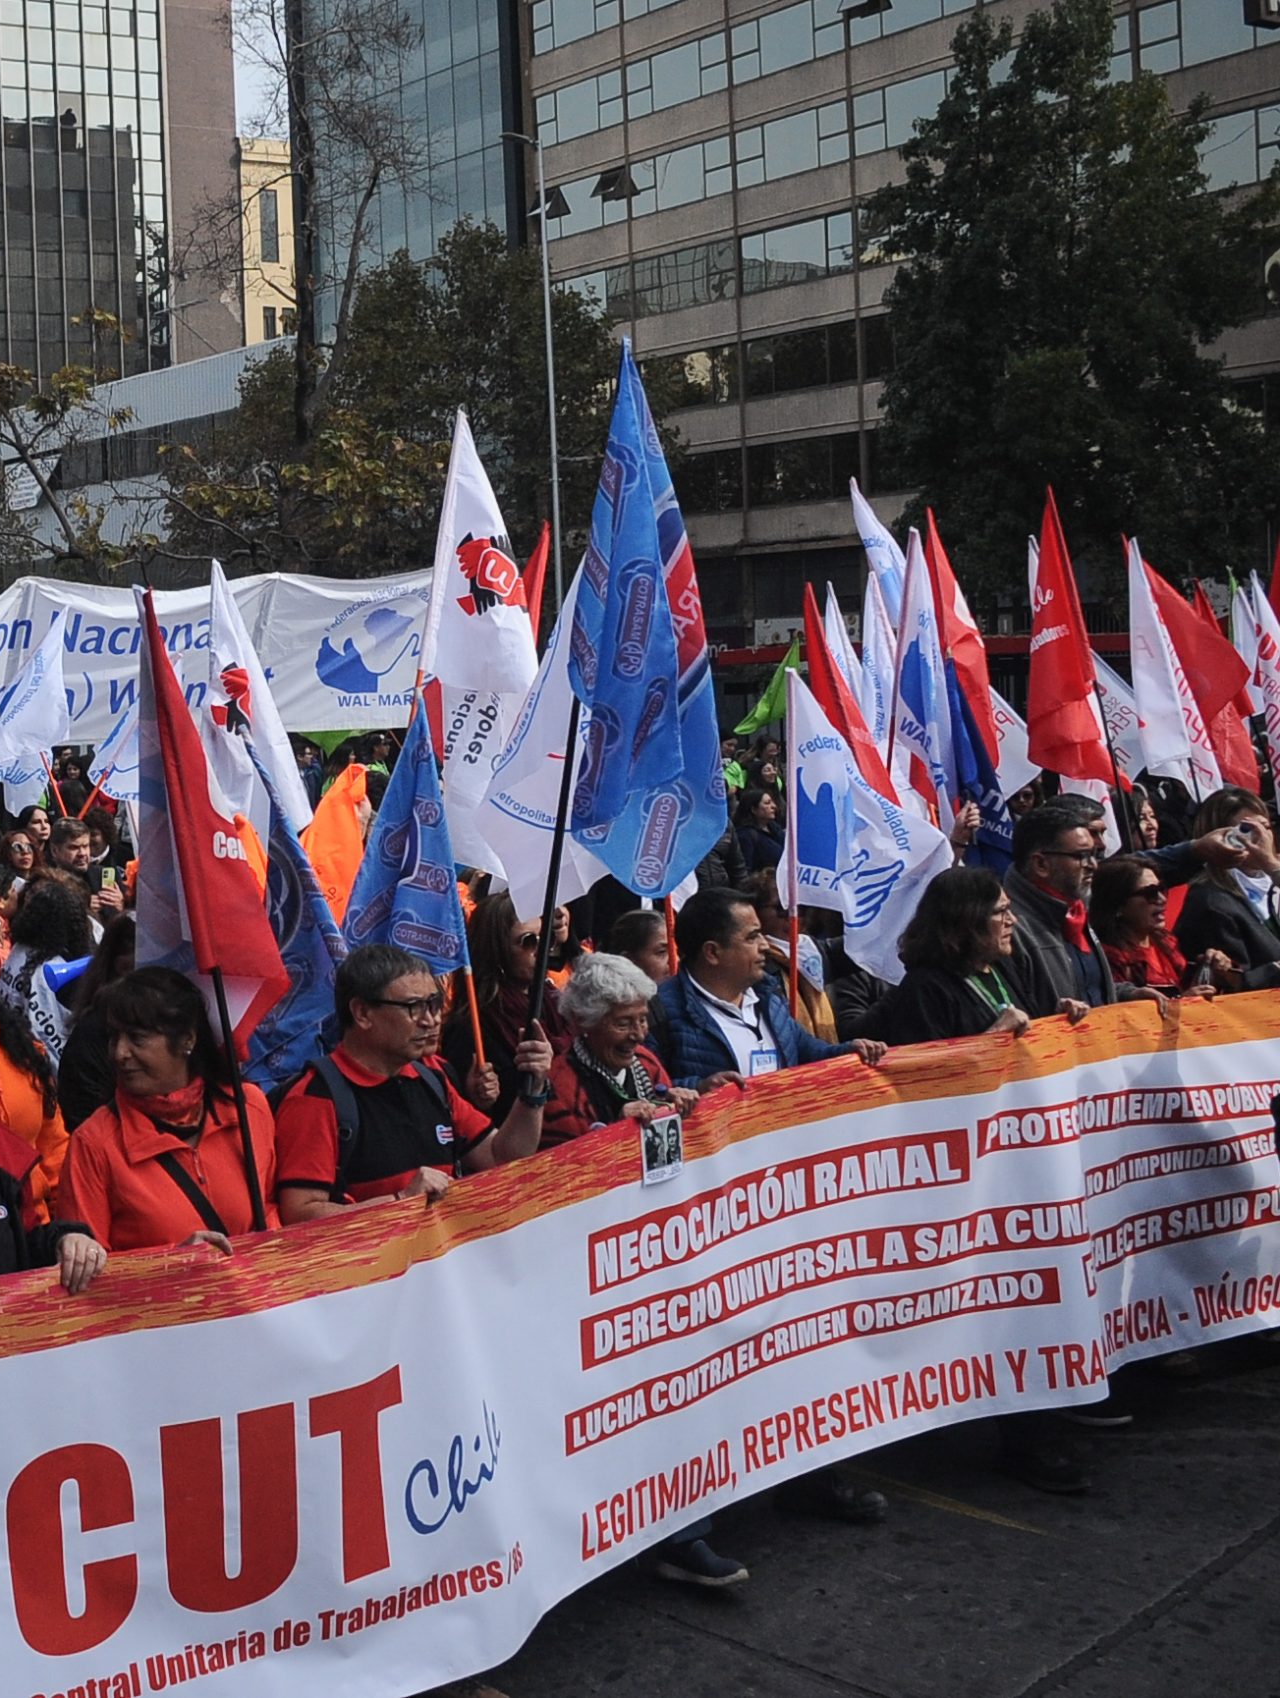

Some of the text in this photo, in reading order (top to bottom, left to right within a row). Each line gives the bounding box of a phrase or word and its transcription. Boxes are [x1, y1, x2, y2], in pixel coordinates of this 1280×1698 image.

[337, 693, 415, 707] WAL-MAR
[1127, 1089, 1214, 1121] EMPLEO
[1128, 1143, 1233, 1181] IMPUNIDAD
[1230, 1142, 1243, 1162] Y
[1243, 1132, 1277, 1160] NEGA
[593, 1141, 962, 1289] NEGOCIACIÓN RAMAL
[1167, 1197, 1250, 1240] SALUD
[592, 1281, 723, 1361] DERECHO
[723, 1235, 878, 1312] UNIVERSAL
[882, 1231, 910, 1266] A
[913, 1212, 1000, 1263] SALA
[572, 1272, 1044, 1449] LUCHA CONTRA EL CRIMEN ORGANIZADO
[6, 1364, 403, 1657] CUT
[581, 1438, 738, 1562] LEGITIMIDAD,
[741, 1353, 997, 1474] REPRESENTACION
[1005, 1349, 1028, 1393] Y
[1037, 1339, 1106, 1390] TRA
[146, 1630, 266, 1692] Unitaria
[273, 1619, 311, 1653] de
[318, 1560, 504, 1642] Trabajadores
